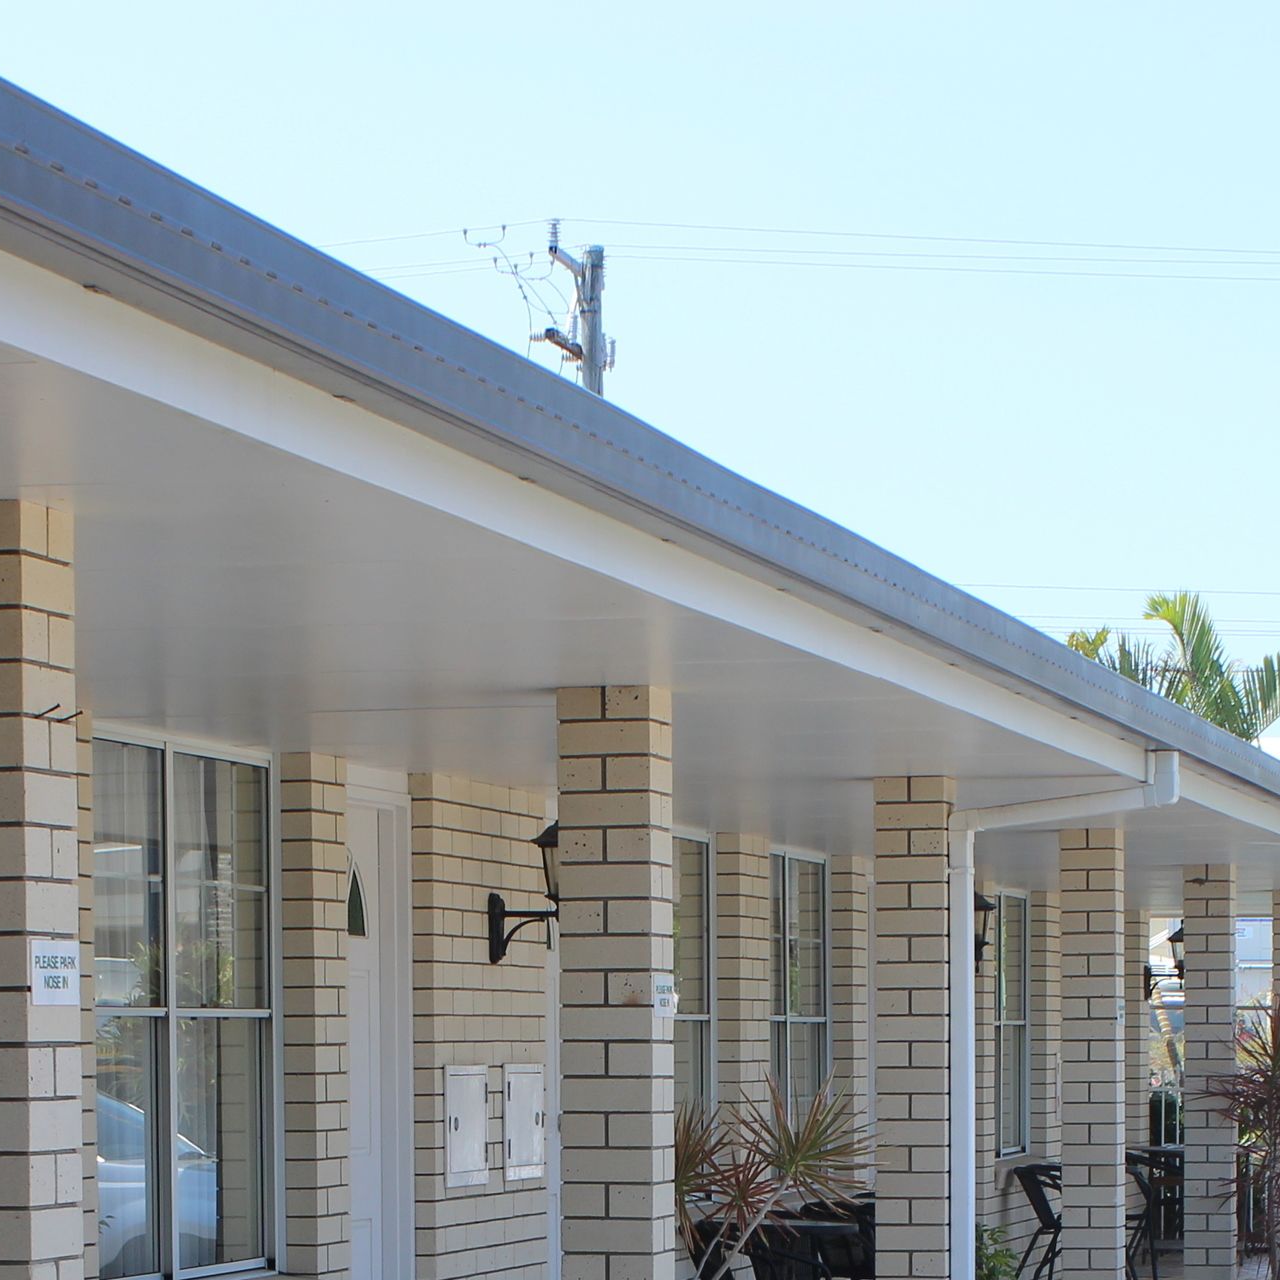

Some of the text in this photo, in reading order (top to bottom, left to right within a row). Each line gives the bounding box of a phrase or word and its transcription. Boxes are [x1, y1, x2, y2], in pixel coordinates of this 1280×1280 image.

[34, 955, 77, 970] PLEASE PARK
[44, 975, 69, 990] NOSE IN
